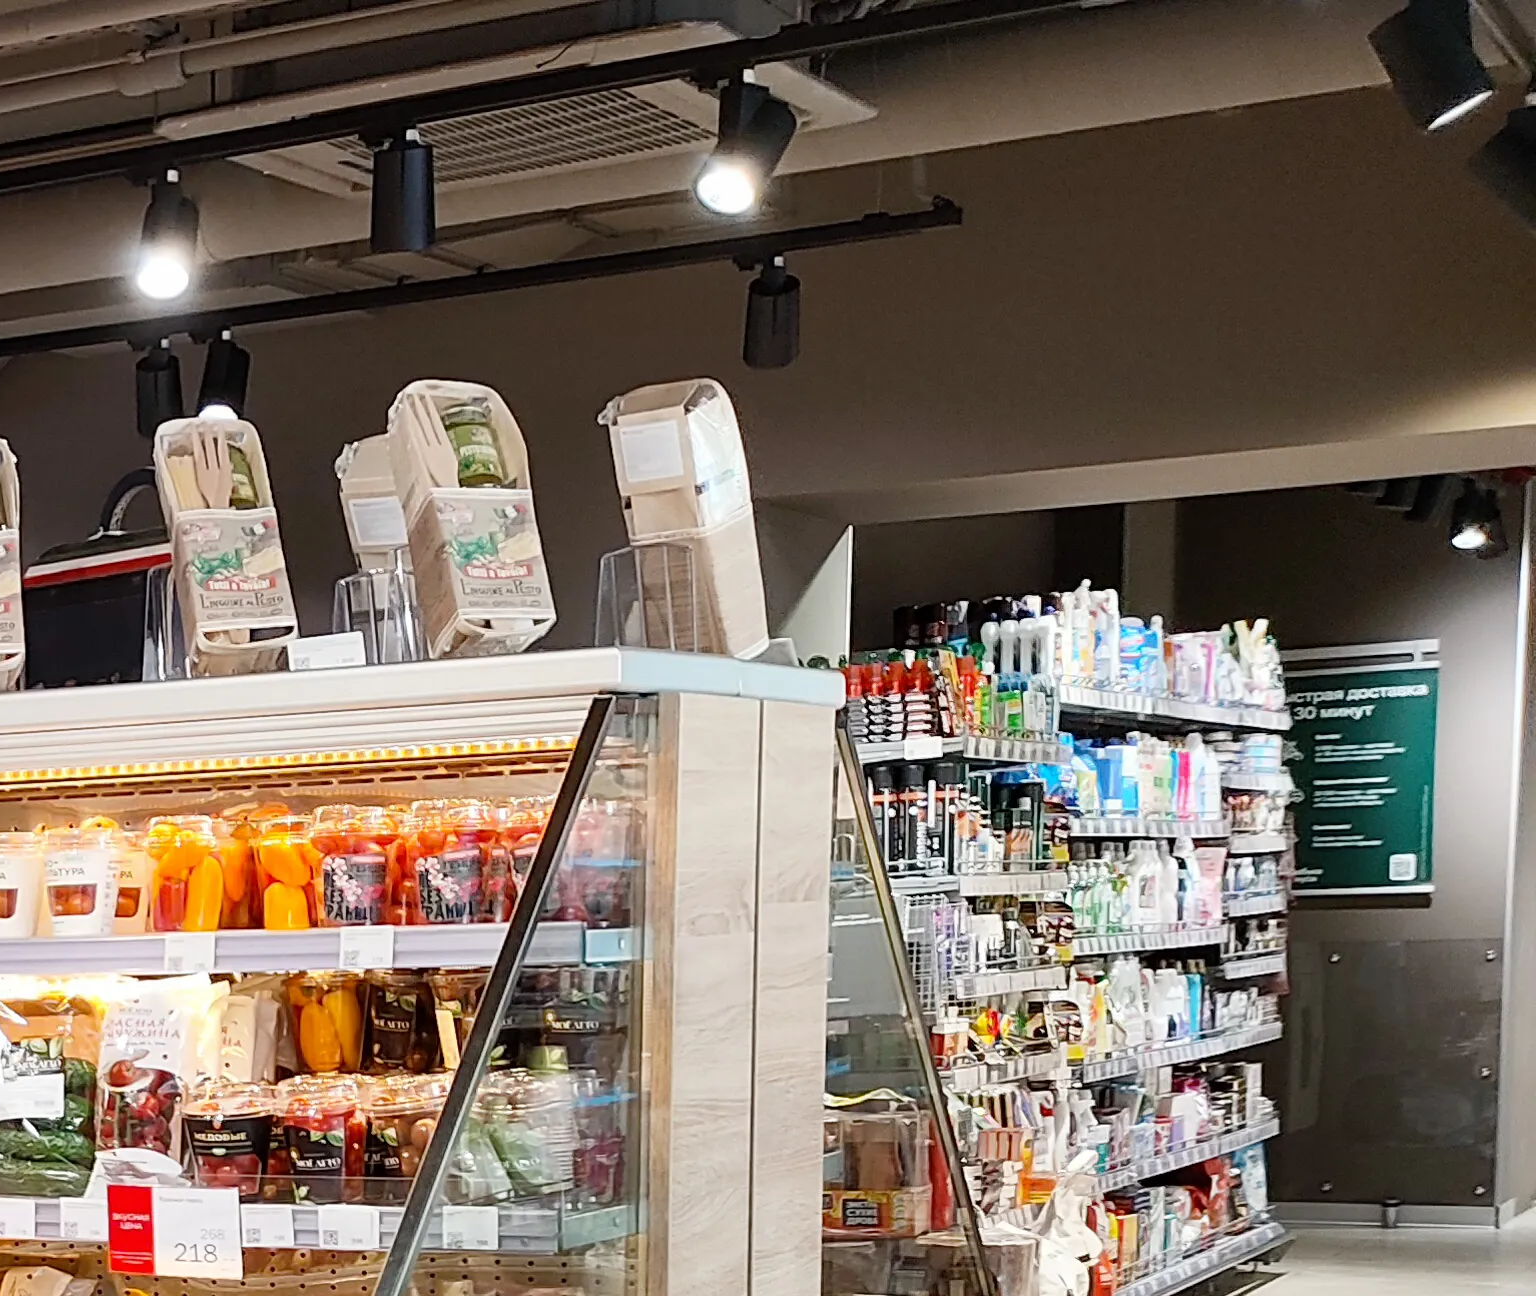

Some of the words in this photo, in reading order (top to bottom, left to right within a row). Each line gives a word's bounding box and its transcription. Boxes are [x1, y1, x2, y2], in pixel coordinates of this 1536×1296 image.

[1345, 683, 1430, 702] доставка
[1293, 706, 1318, 720] 30
[1319, 704, 1377, 720] минут
[112, 1211, 150, 1222] ВКУСНАЯ
[199, 1227, 226, 1240] 268
[173, 1241, 219, 1263] 218
